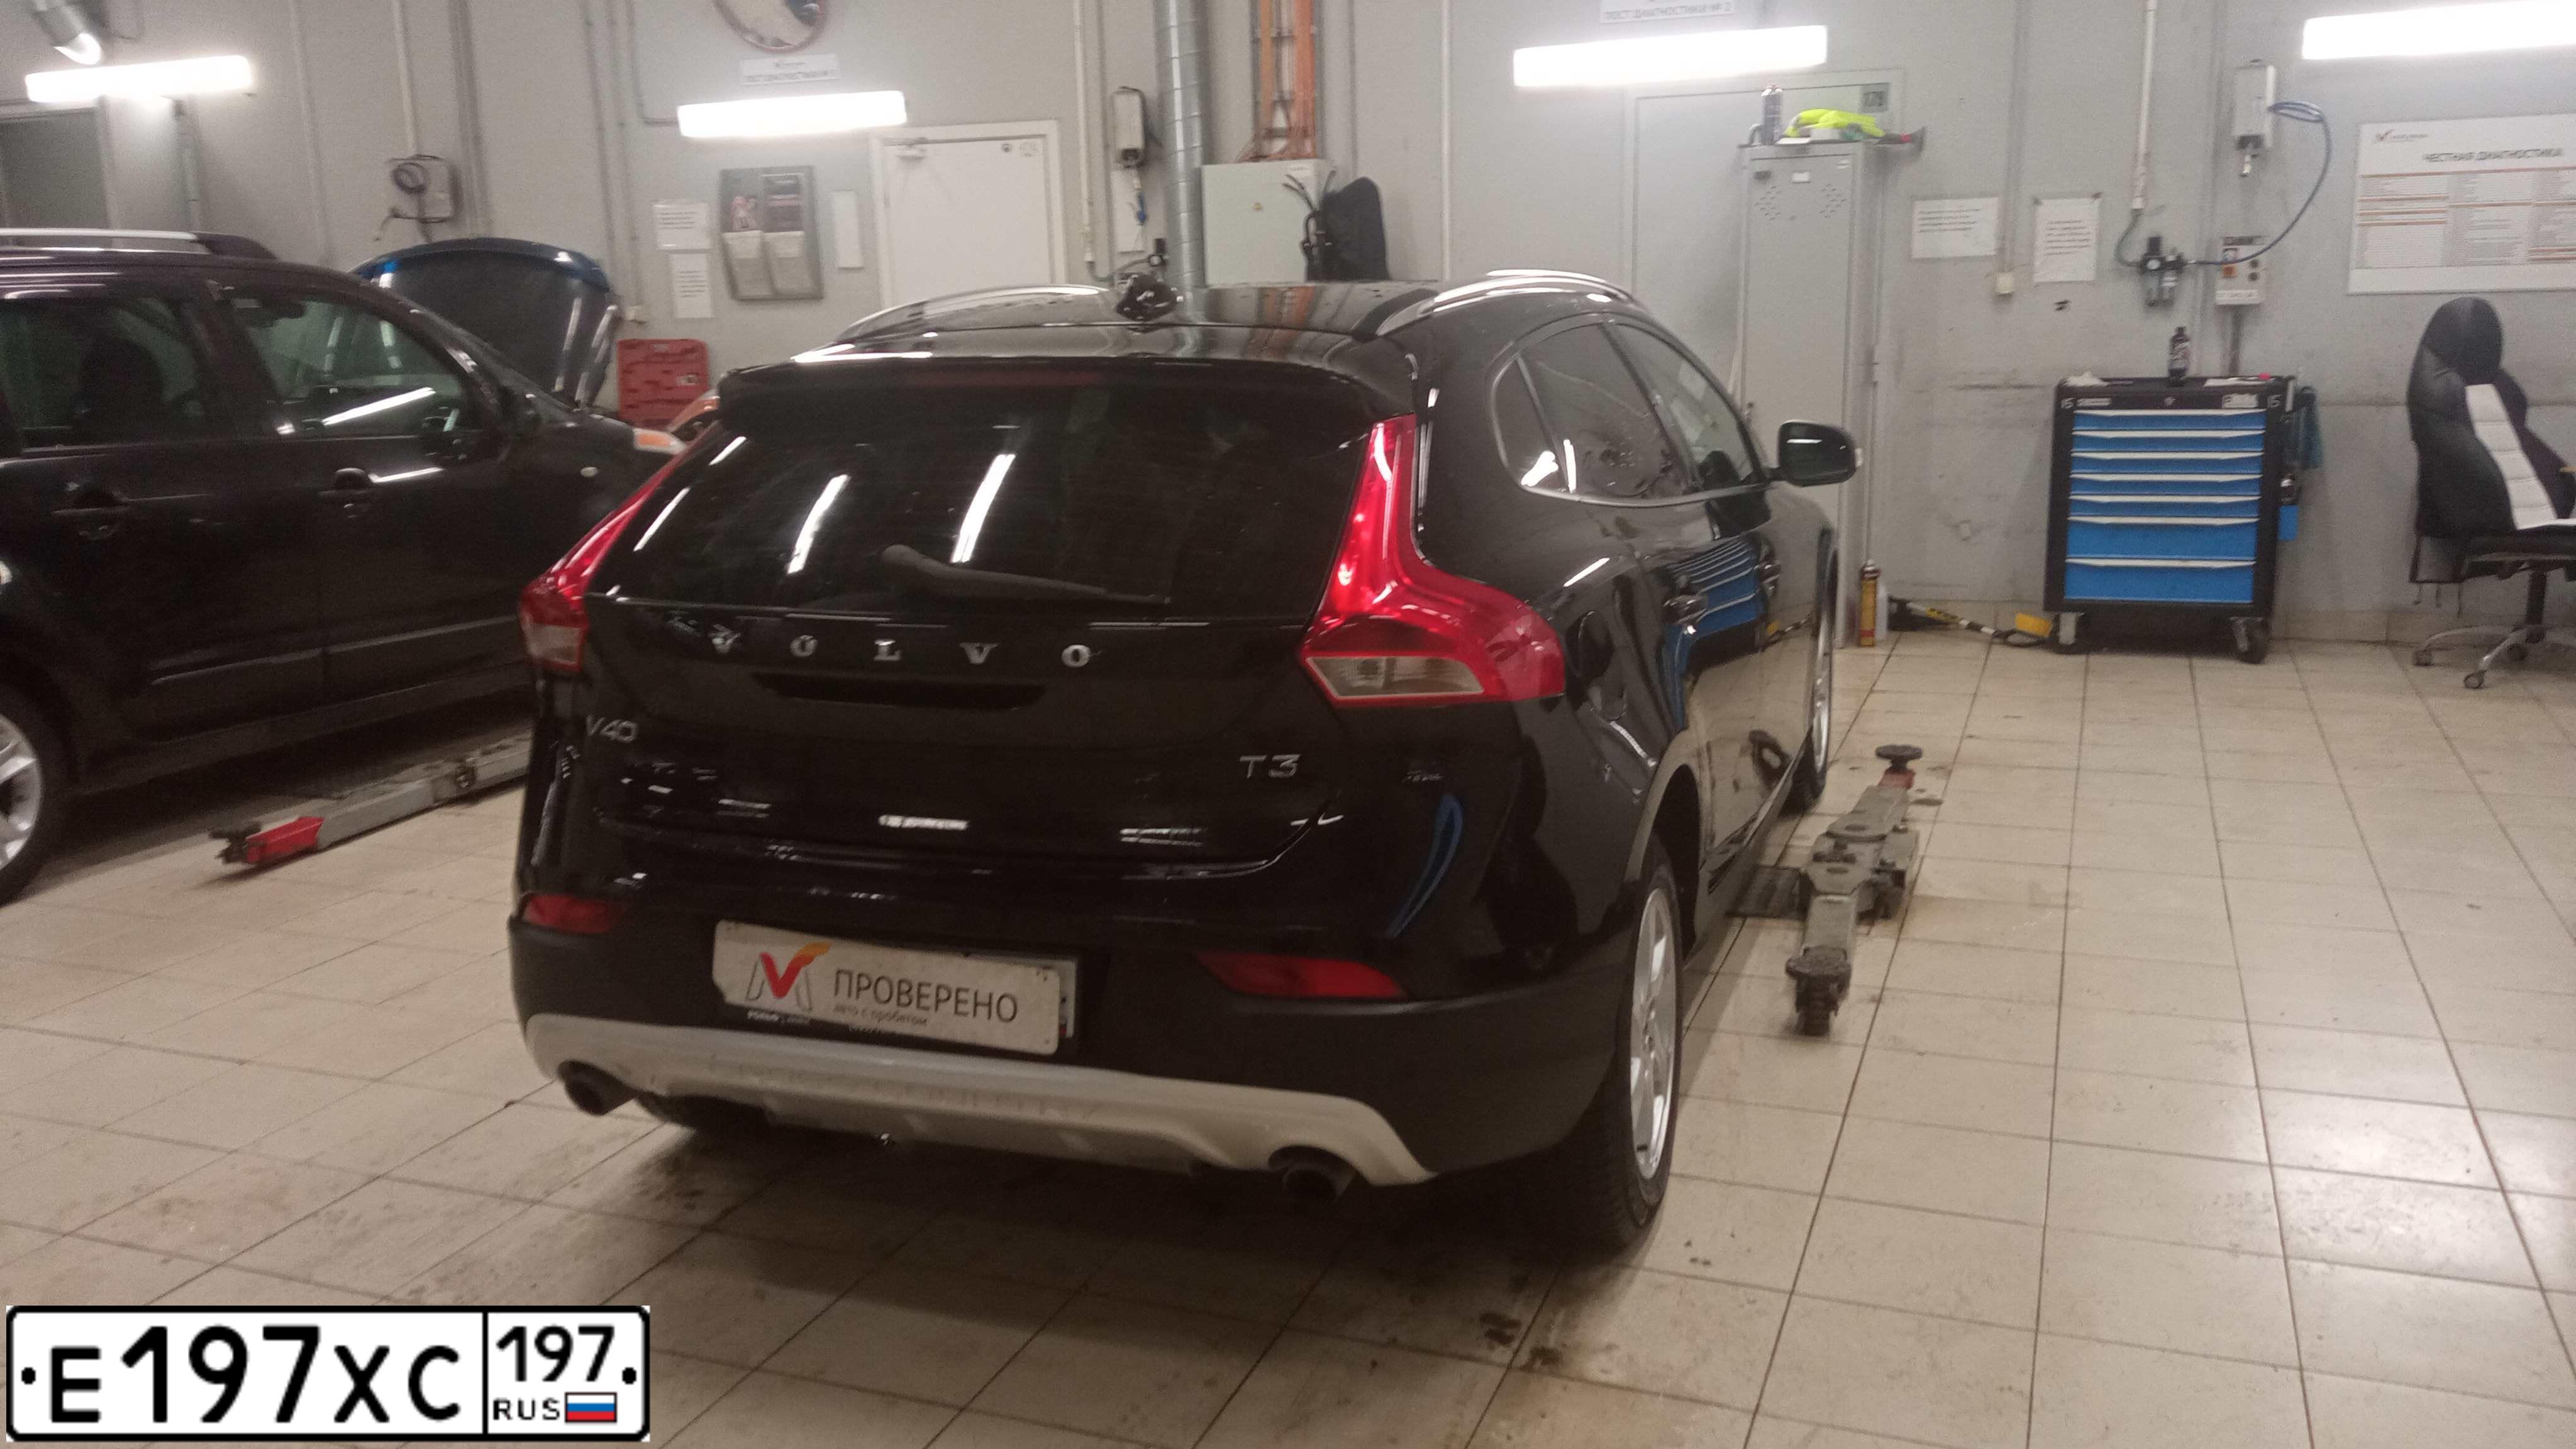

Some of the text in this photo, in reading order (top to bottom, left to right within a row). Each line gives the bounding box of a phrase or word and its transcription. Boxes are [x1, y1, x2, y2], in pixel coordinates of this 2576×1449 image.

[711, 625, 1090, 667] VOLVO
[586, 714, 637, 742] V40
[1240, 754, 1301, 779] T3
[834, 969, 1018, 1023] ПРОВЕРЕНО
